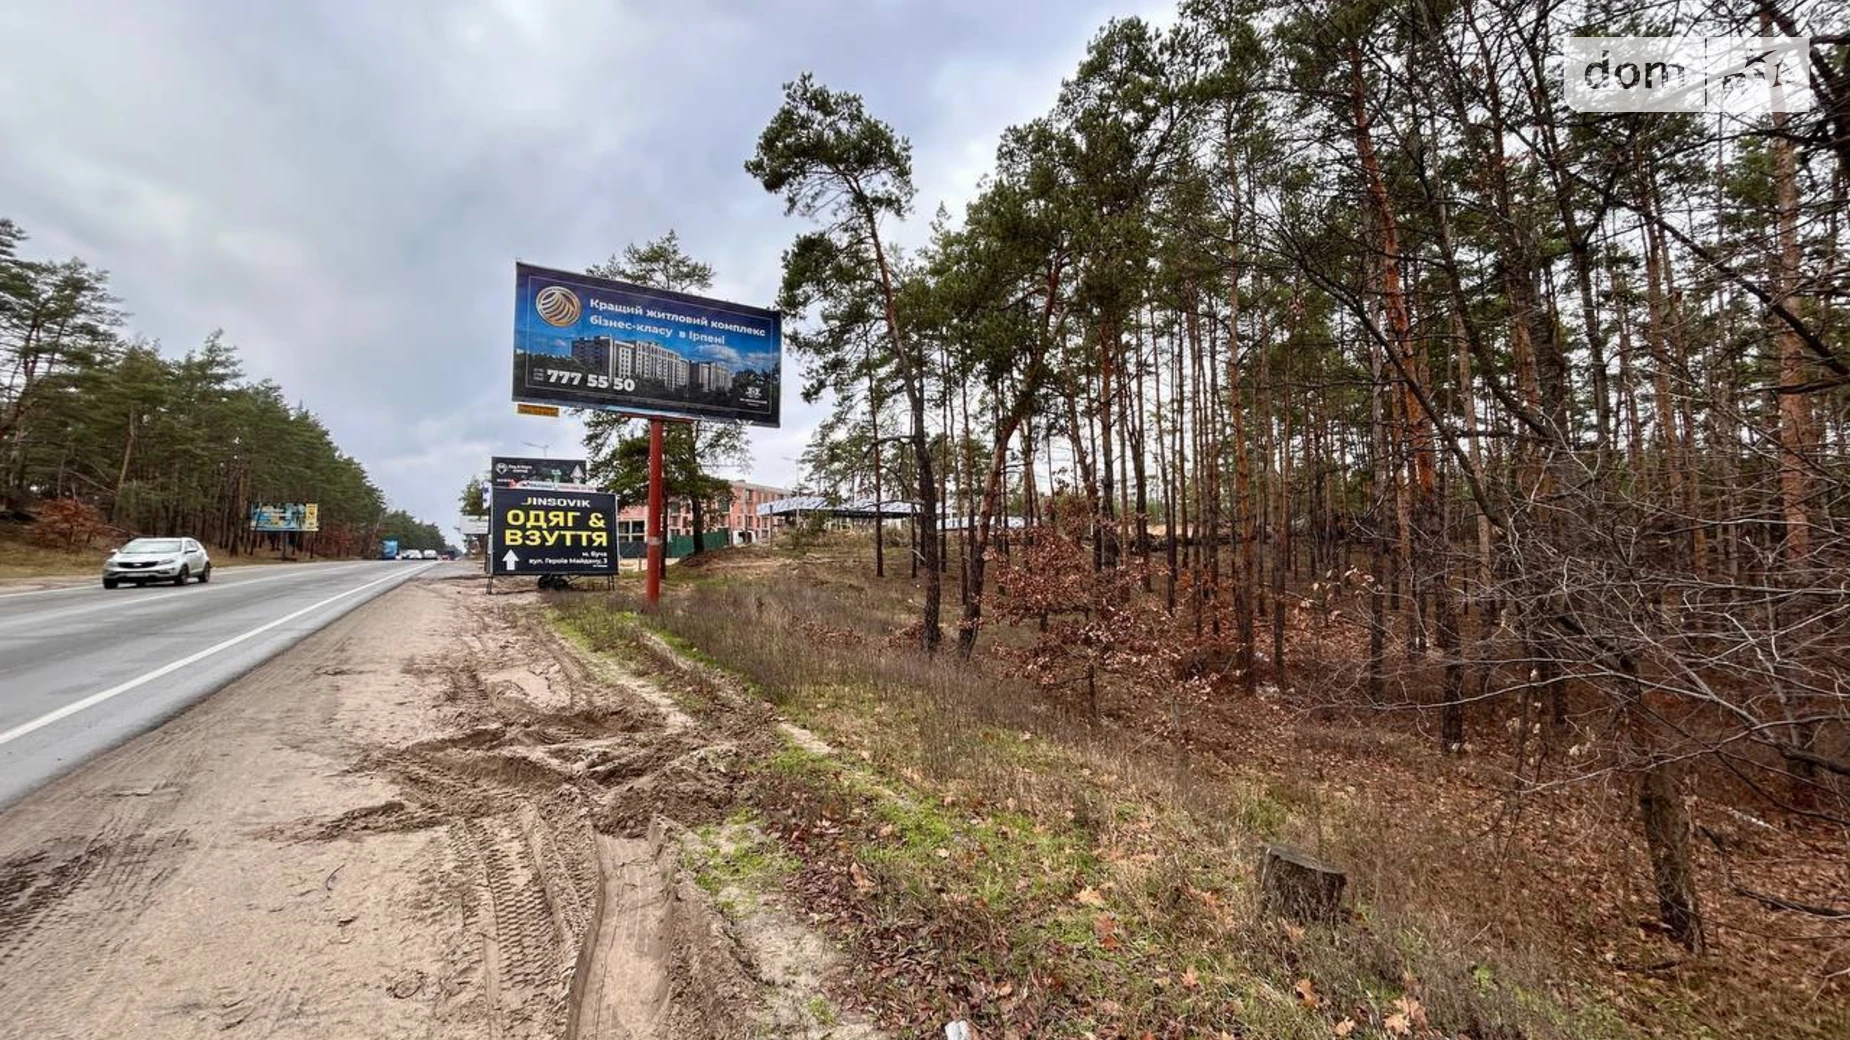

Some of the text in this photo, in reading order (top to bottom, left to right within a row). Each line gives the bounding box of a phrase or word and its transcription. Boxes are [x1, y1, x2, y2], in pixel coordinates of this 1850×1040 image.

[589, 298, 766, 337] Кращий житловий комплекс
[589, 315, 726, 345] бізнес-класу в Ірпені
[547, 369, 582, 385] 777
[586, 374, 609, 388] 55
[613, 377, 636, 392] 50
[521, 497, 591, 508] JINSOVIK
[506, 510, 606, 529] ОДЯГ &
[505, 529, 608, 547] ВЗУТТЯ
